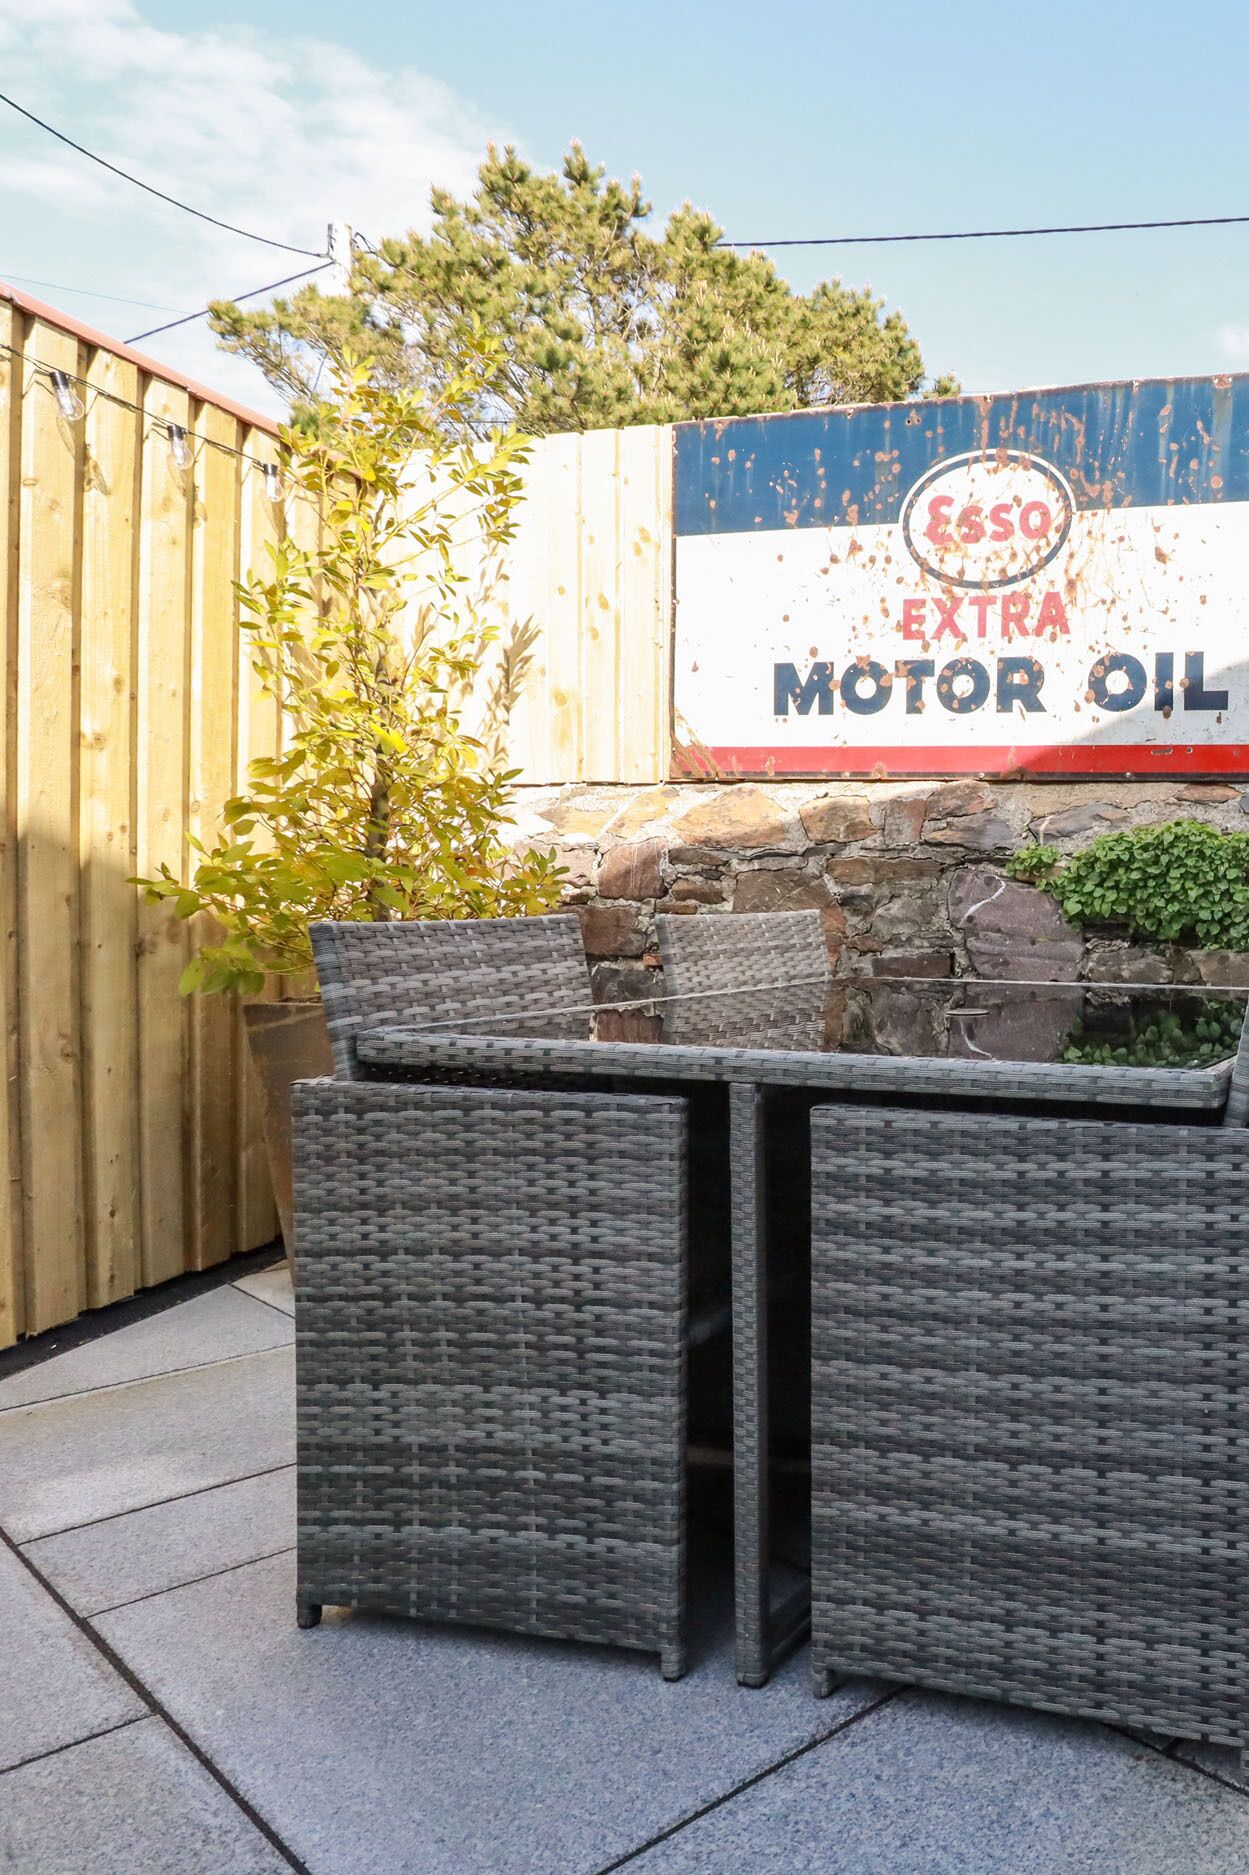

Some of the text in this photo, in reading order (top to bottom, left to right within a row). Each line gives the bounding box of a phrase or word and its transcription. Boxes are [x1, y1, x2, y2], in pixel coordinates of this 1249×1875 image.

[902, 591, 1071, 641] EXTRA
[773, 652, 1229, 716] MOTOR OIL
